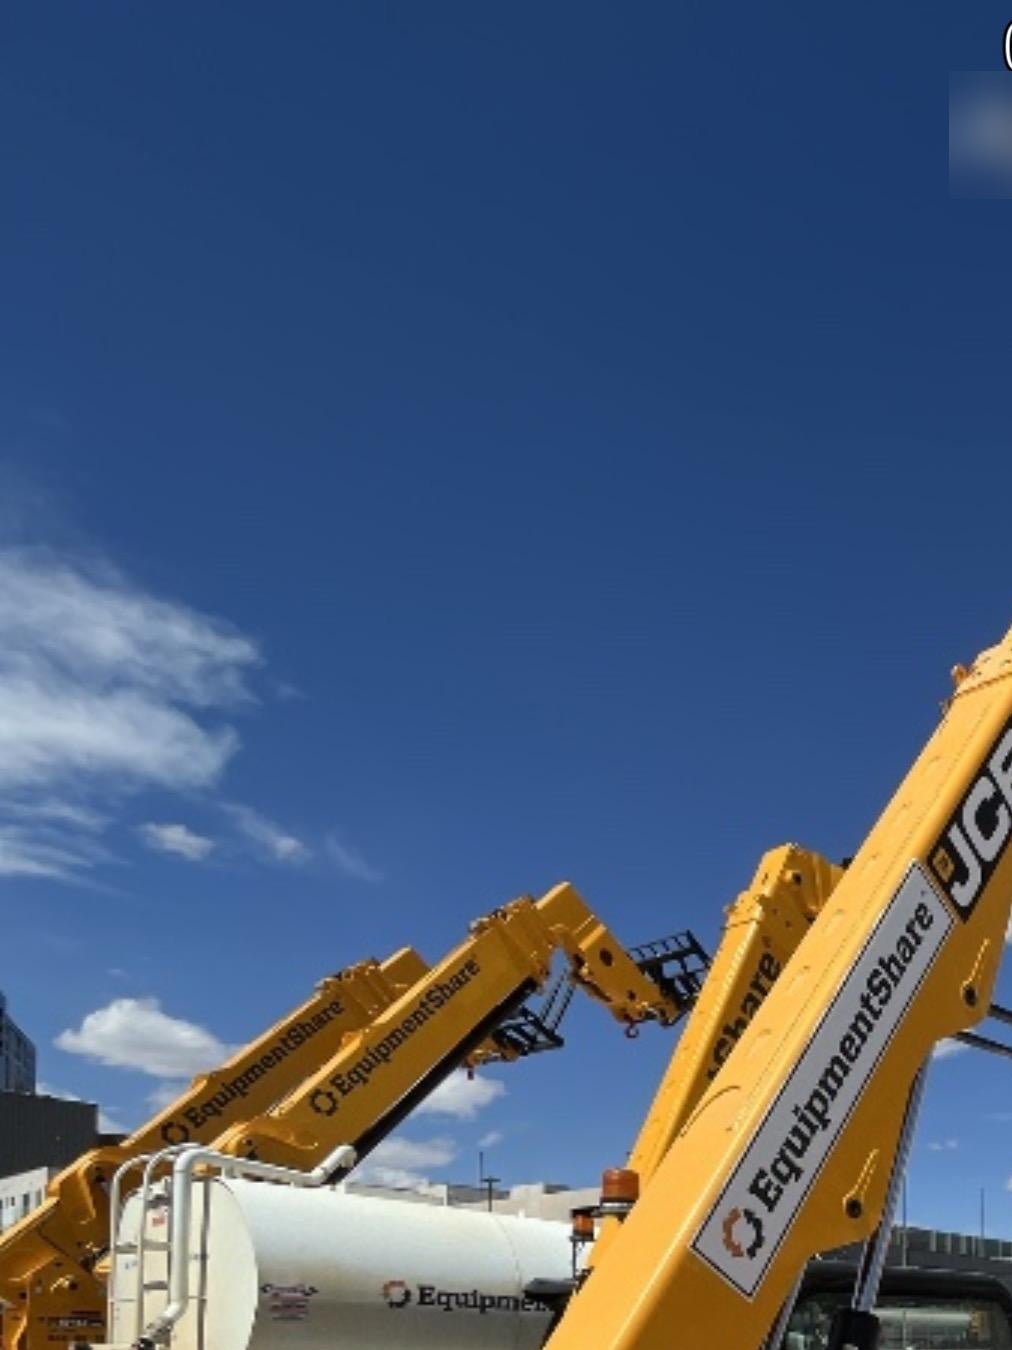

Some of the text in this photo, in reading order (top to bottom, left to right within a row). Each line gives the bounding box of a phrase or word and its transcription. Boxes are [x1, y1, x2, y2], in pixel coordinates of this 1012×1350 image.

[186, 1000, 343, 1128] EquipmentShare
[332, 957, 480, 1097] EquipmentShare
[749, 902, 934, 1212] EquipmentShare
